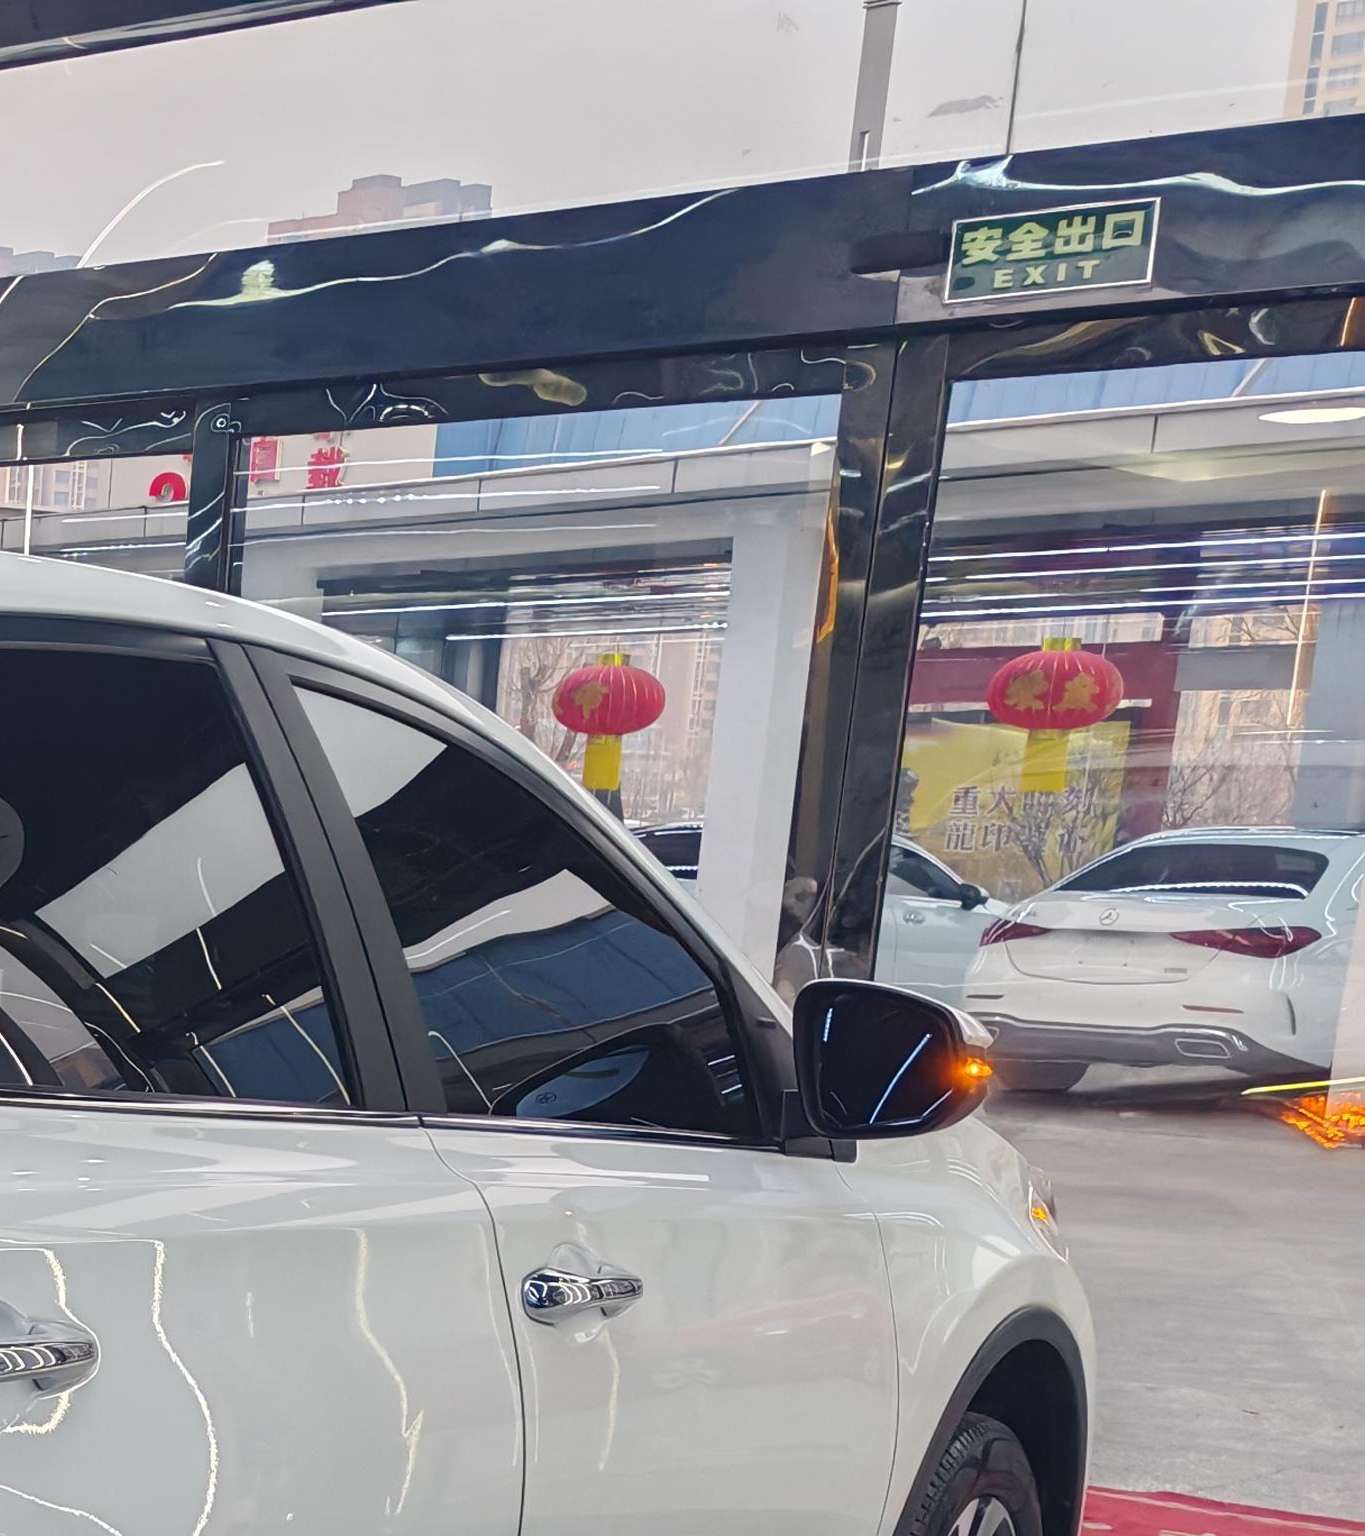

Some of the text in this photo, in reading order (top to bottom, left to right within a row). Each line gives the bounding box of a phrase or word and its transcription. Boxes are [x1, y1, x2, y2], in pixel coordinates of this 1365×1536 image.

[962, 211, 1146, 267] 安全出口
[993, 259, 1100, 289] EXIT
